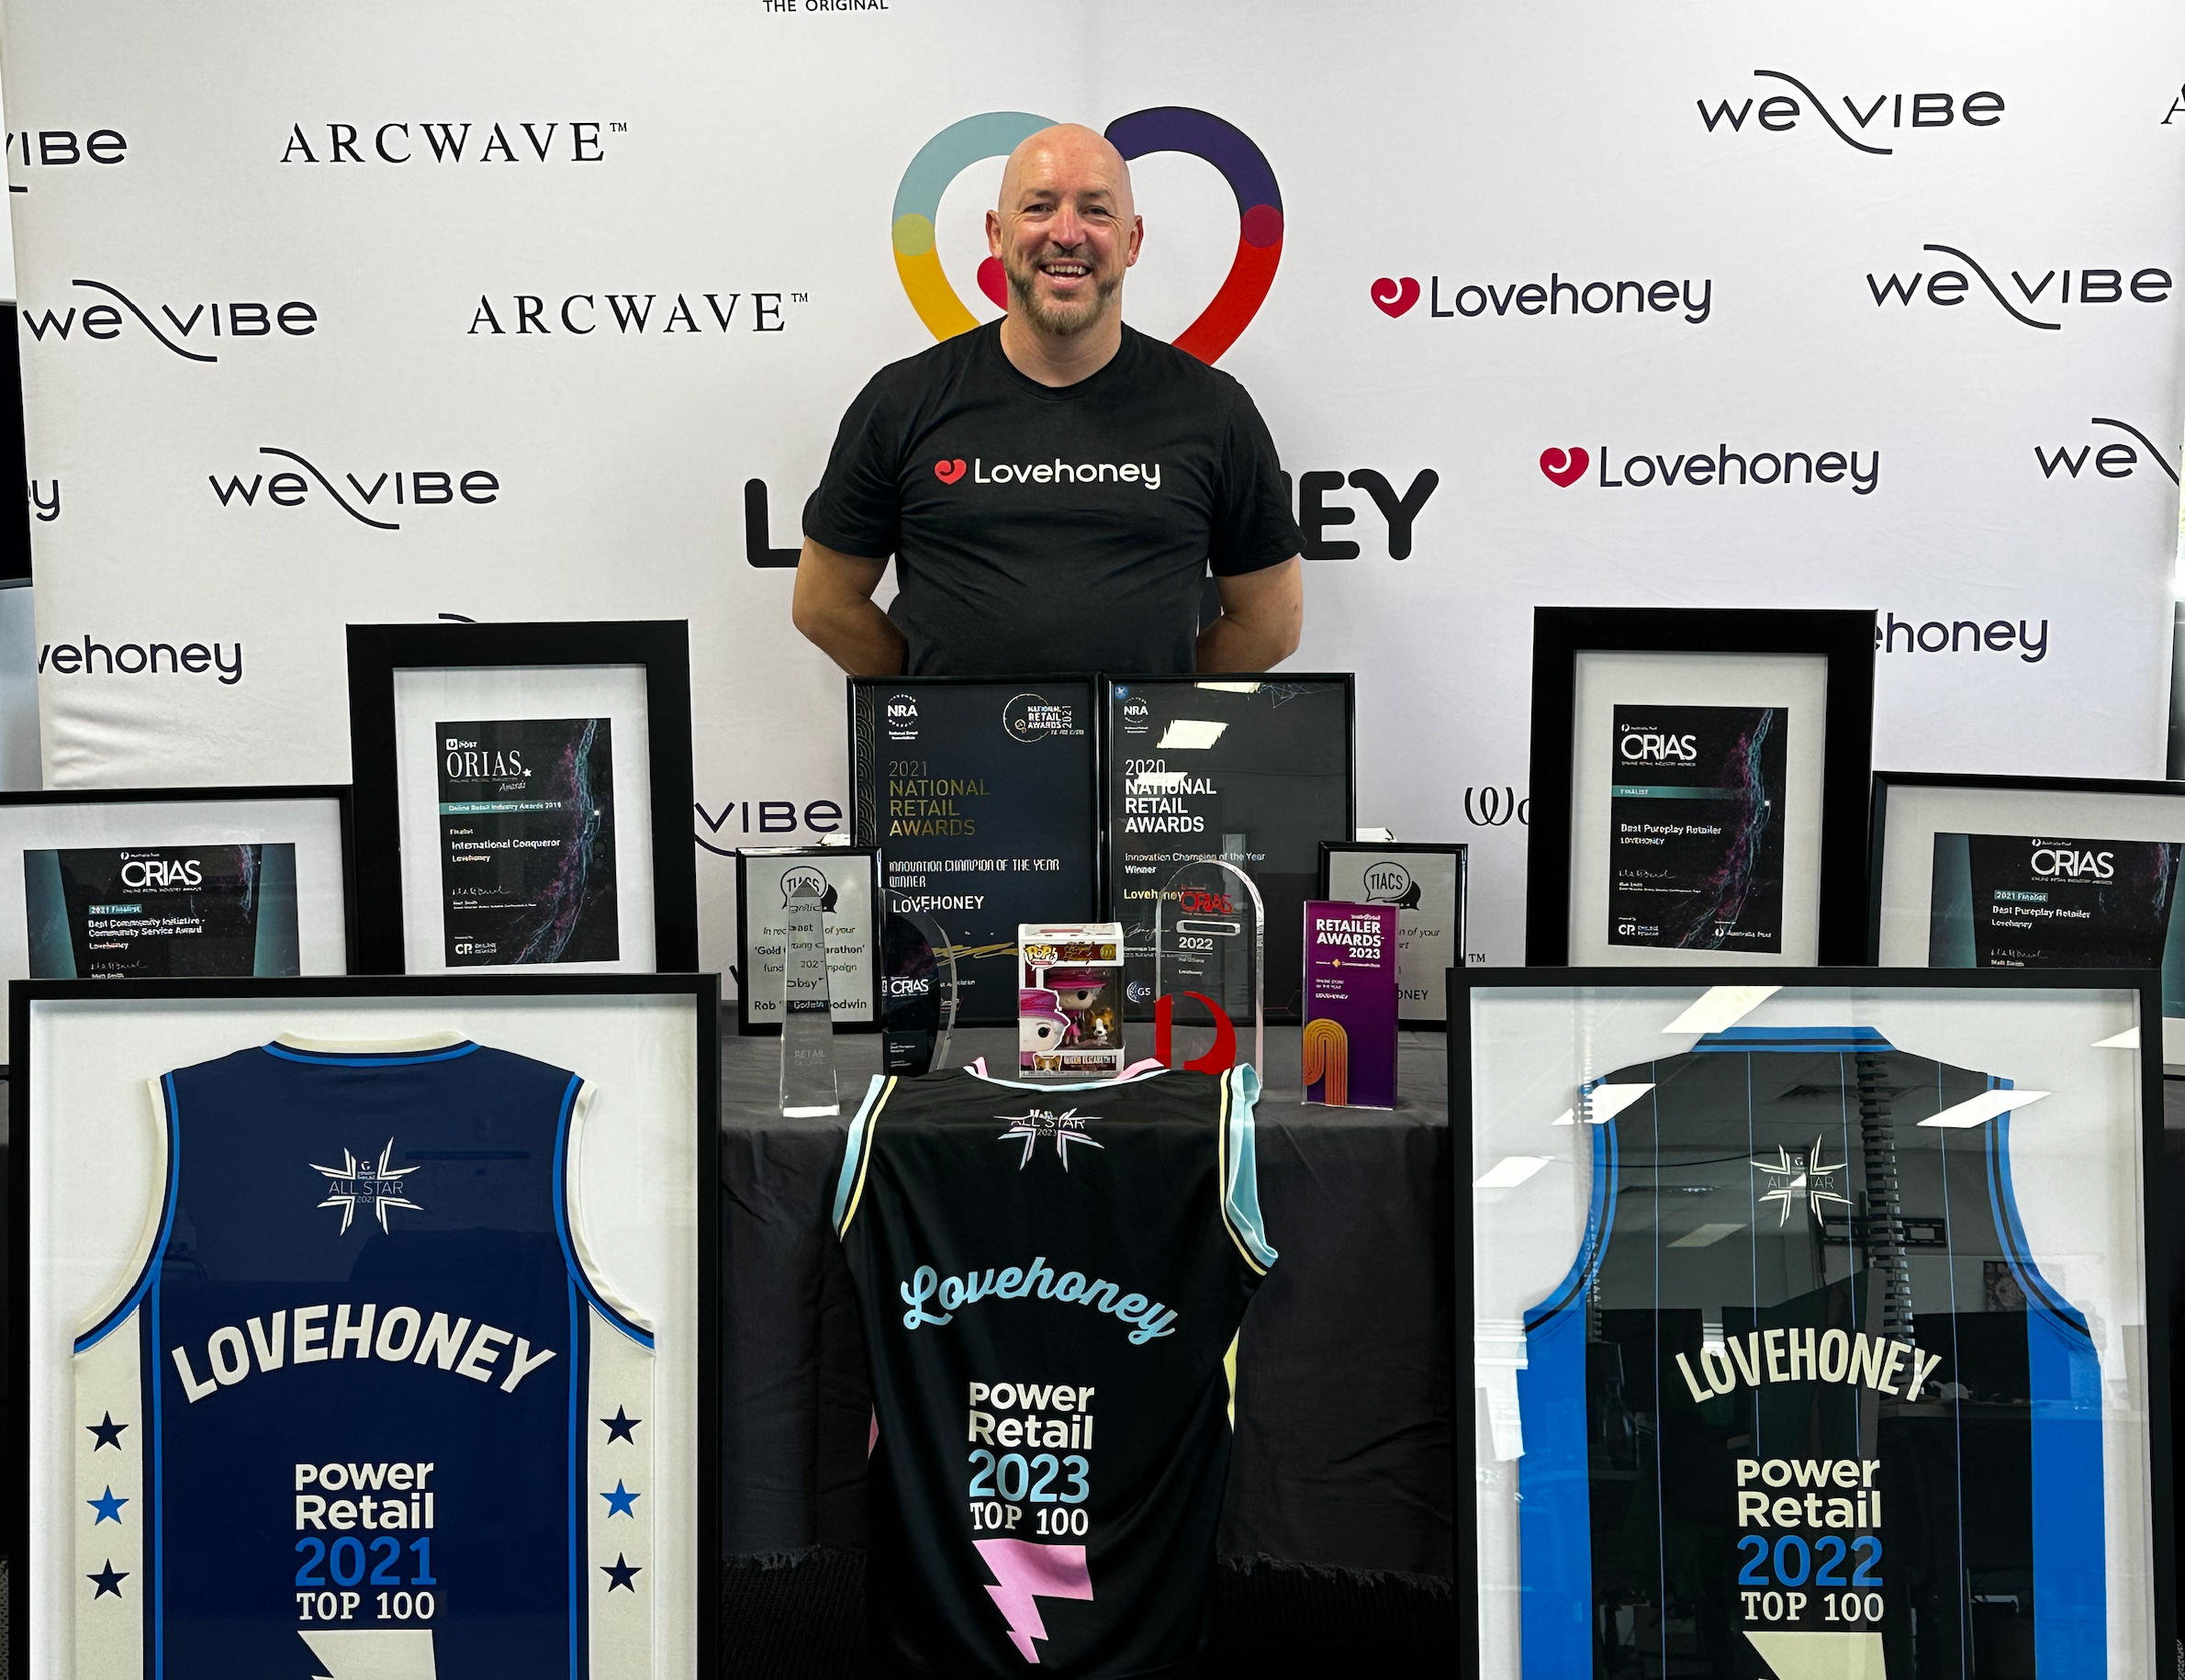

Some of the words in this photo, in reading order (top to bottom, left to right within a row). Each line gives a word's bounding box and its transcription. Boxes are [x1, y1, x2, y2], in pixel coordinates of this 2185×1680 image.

[763, 0, 797, 12] THE
[805, 0, 889, 11] ORIGINAL
[1431, 273, 1712, 324] Lovehoney
[974, 458, 1161, 490] Lovehoney
[1599, 443, 1880, 496] Lovehoney
[888, 705, 918, 717] NRA
[1028, 712, 1062, 722] RETAIL
[1124, 705, 1149, 715] NRA
[446, 750, 522, 778] ORIAS
[889, 761, 927, 777] 2021
[1125, 759, 1166, 776] 2020
[889, 779, 991, 797] NATIONAL
[1125, 778, 1216, 795] NATIONAL
[889, 800, 960, 816] RETAIL
[1125, 797, 1188, 814] RETAIL
[889, 819, 976, 836] AWARDS
[1125, 816, 1205, 833] AWARDS
[1620, 823, 1642, 834] Best
[452, 840, 510, 850] International
[512, 839, 561, 849] Conqueror
[996, 859, 1009, 871] OF
[1013, 859, 1030, 871] THE
[1125, 853, 1171, 862] Innovation
[1246, 853, 1266, 861] Year
[1125, 865, 1157, 874] Winner
[892, 895, 985, 913] LOVEHONEY
[1124, 889, 1183, 902] Lovehney
[1996, 891, 2016, 900] 2021
[836, 924, 856, 935] your
[1316, 919, 1381, 934] RETAILER
[1419, 928, 1440, 937] your
[1179, 936, 1214, 950] 2022
[1317, 933, 1382, 947] AWARDS
[1349, 947, 1381, 959] 2023
[755, 1001, 776, 1010] Rob
[329, 1181, 358, 1194] ALL
[364, 1181, 403, 1194] STAR
[900, 1256, 1179, 1345] Lovehoney
[172, 1304, 556, 1404] LOVEHONEY
[1675, 1327, 1942, 1403] LOVEHONEY
[968, 1409, 1093, 1450] Retail
[968, 1449, 1090, 1504] 2023
[296, 1492, 434, 1530] Retail
[1738, 1490, 1882, 1528] Retail
[969, 1501, 1023, 1530] TOP
[1036, 1507, 1089, 1536] 100
[295, 1536, 437, 1587] 2021
[1737, 1534, 1883, 1587] 2022
[296, 1591, 361, 1621] TOP
[376, 1591, 435, 1620] 100
[1741, 1591, 1808, 1621] TOP
[1823, 1592, 1885, 1622] 100
